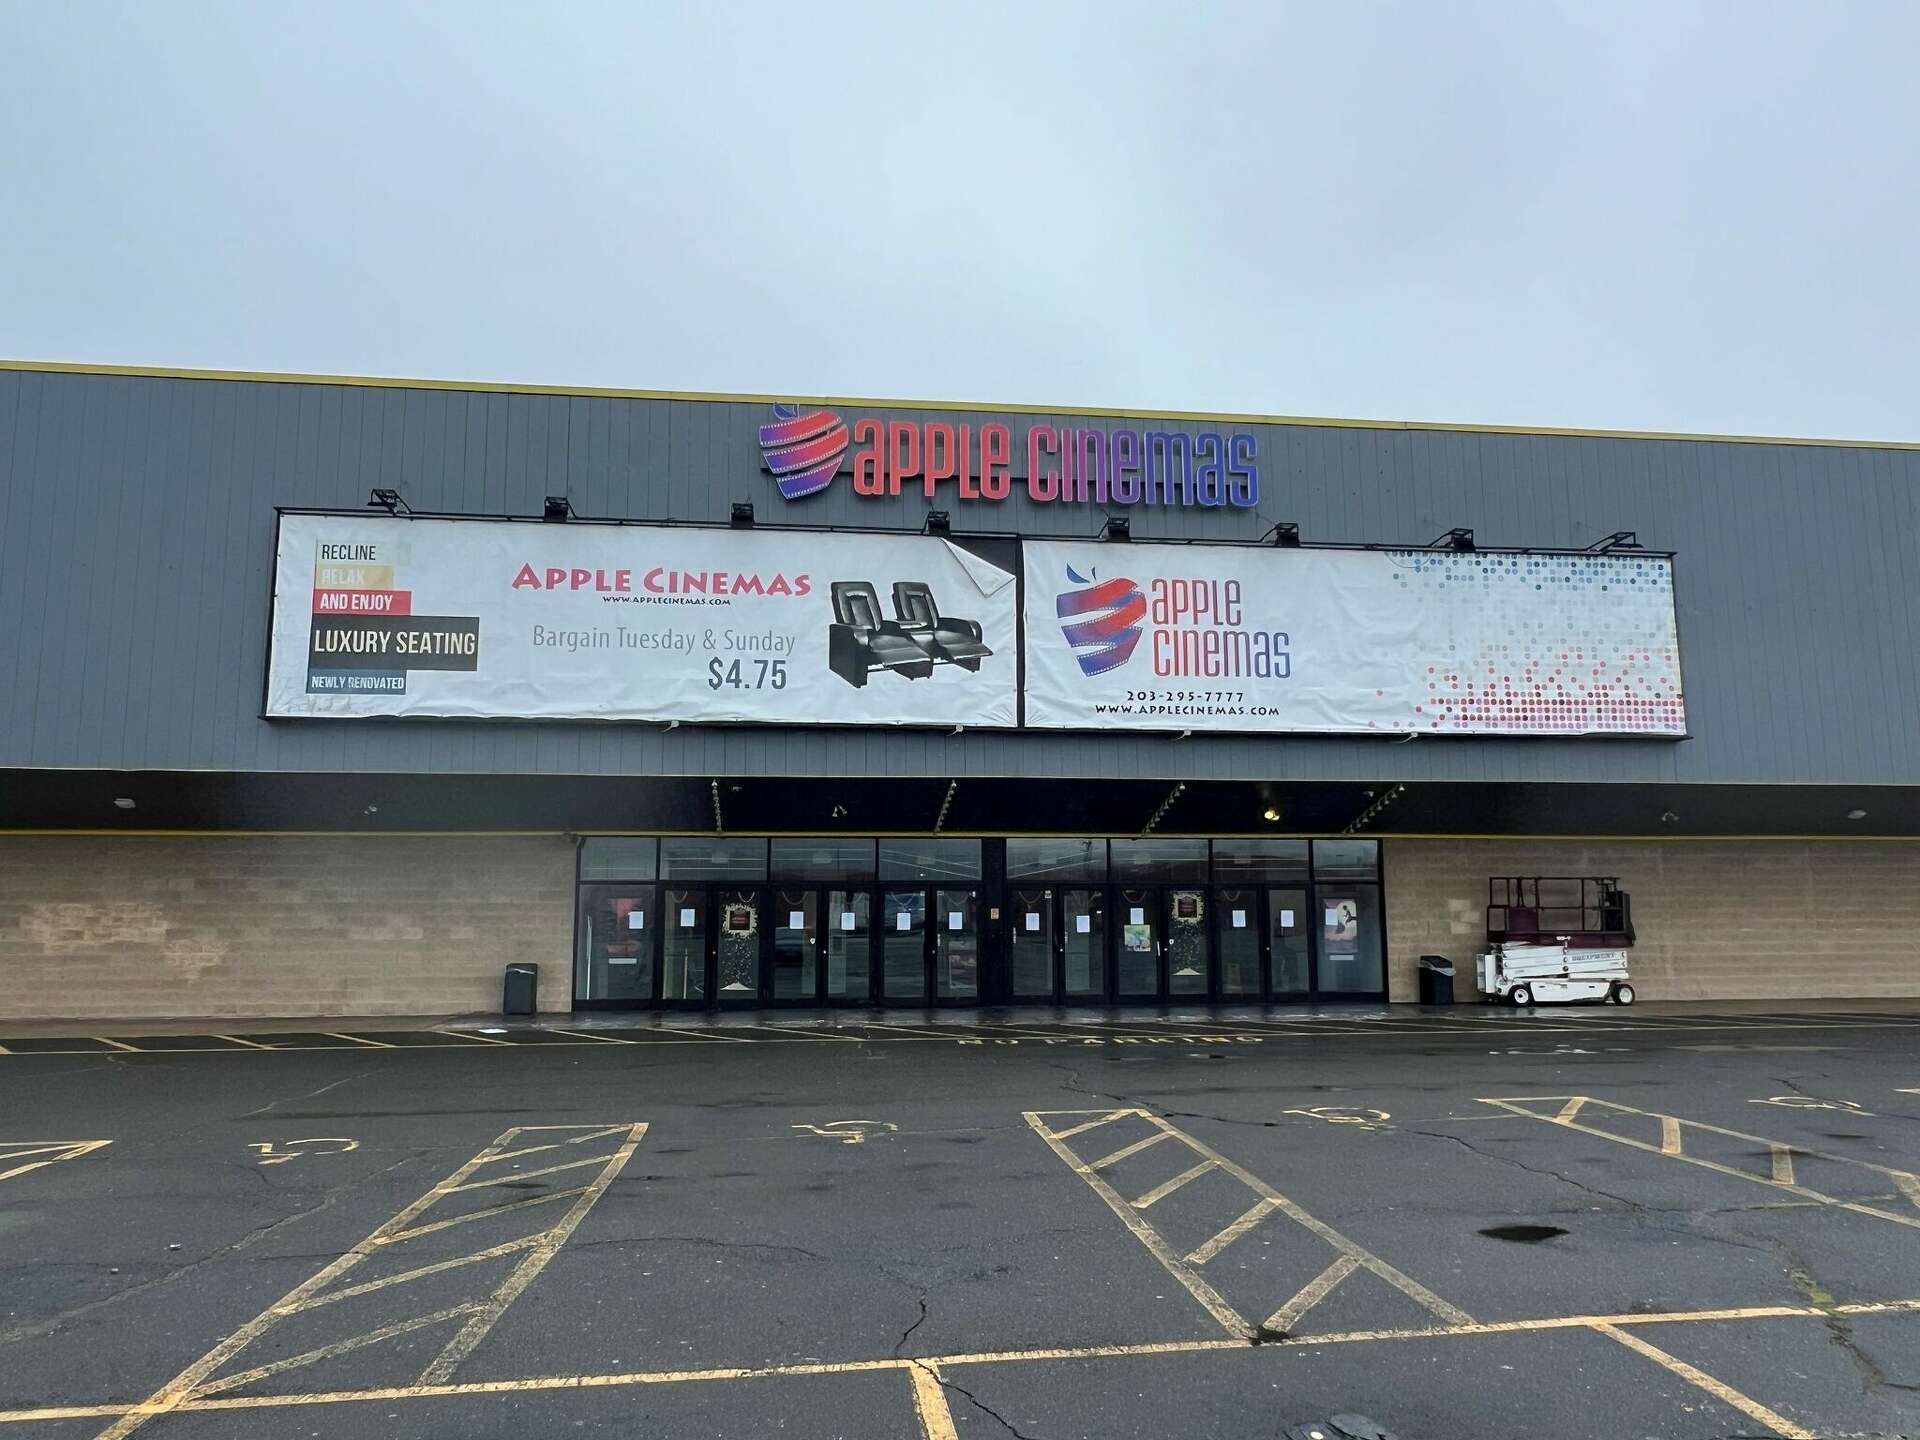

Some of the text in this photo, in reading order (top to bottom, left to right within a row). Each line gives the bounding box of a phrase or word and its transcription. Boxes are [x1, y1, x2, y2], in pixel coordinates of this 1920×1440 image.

[853, 417, 1260, 508] apple cinemas
[321, 544, 377, 560] RECLINE
[321, 568, 366, 585] RELAX
[511, 562, 812, 597] APPLE CINEMAS
[320, 593, 393, 611] AND ENJOY
[1151, 578, 1242, 627] apple
[314, 629, 477, 655] LUXURY SEATING
[532, 625, 796, 656] Bargain Tuesday & Sunday
[1152, 629, 1291, 679] cinemas
[311, 676, 405, 690] NEWLY RENOVATED
[707, 656, 787, 691] $4.75
[1127, 691, 1244, 702] 203-295-7777
[1095, 704, 1280, 716] WWW.APPLECINEMAS.COM
